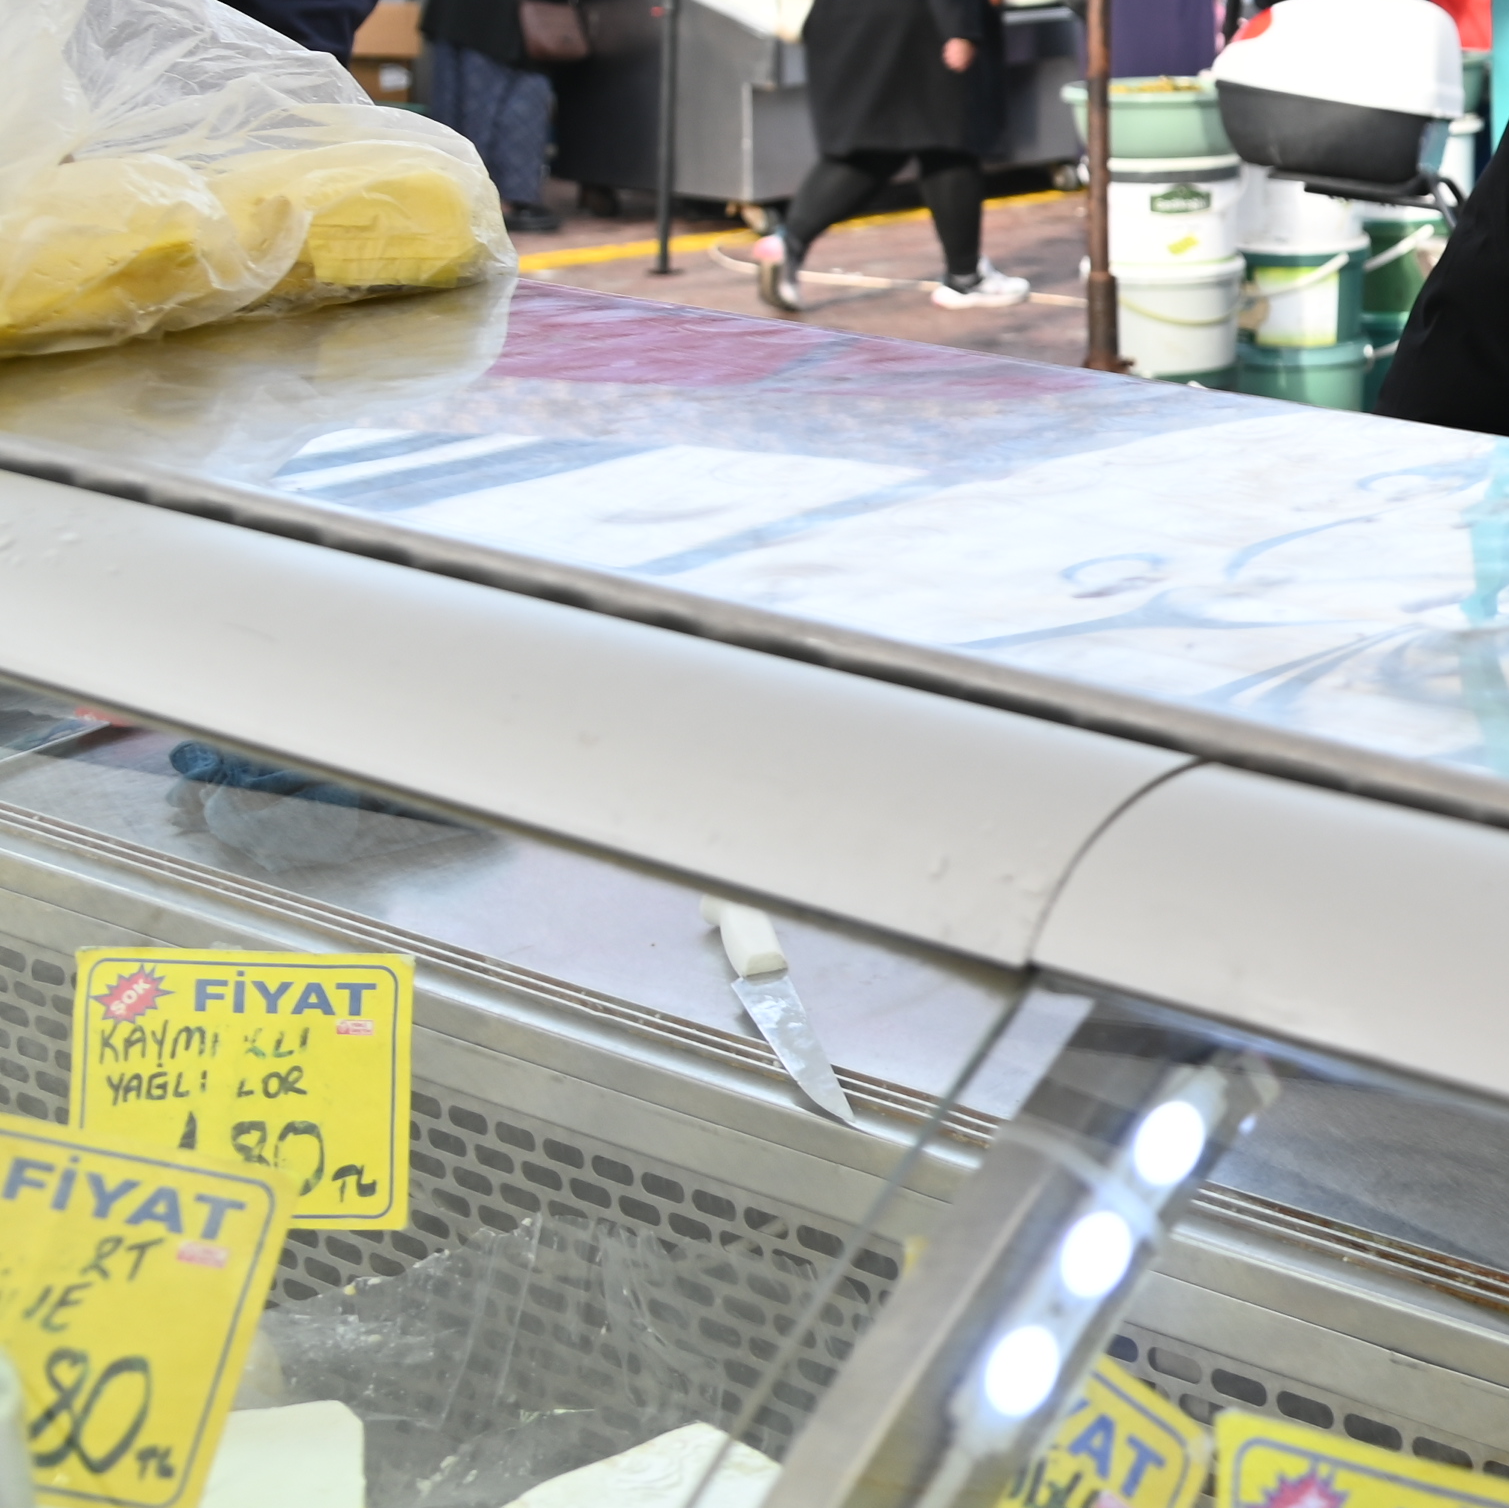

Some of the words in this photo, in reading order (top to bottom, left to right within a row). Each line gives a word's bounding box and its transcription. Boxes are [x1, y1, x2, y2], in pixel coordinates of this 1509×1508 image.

[109, 978, 152, 1016] ŞOK
[194, 970, 378, 1017] FİYAT
[1, 1155, 247, 1240] FİYAT
